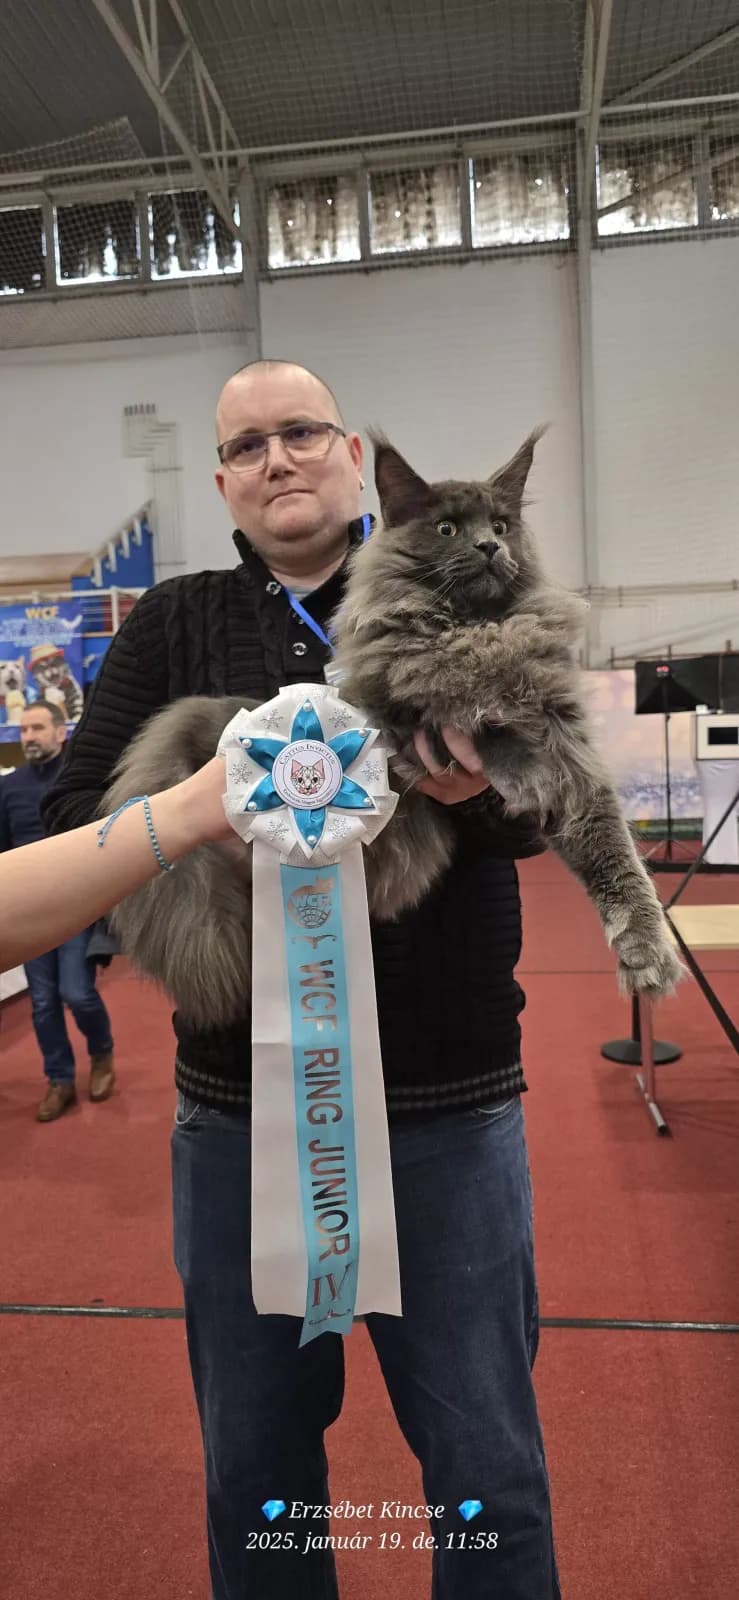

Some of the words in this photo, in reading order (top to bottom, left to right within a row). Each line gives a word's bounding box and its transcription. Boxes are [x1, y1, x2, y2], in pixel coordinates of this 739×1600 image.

[25, 606, 59, 620] WCF
[298, 959, 338, 1032] WCF
[303, 1047, 344, 1126] RING
[308, 1138, 351, 1262] JUNIOR
[312, 1262, 353, 1308] IV
